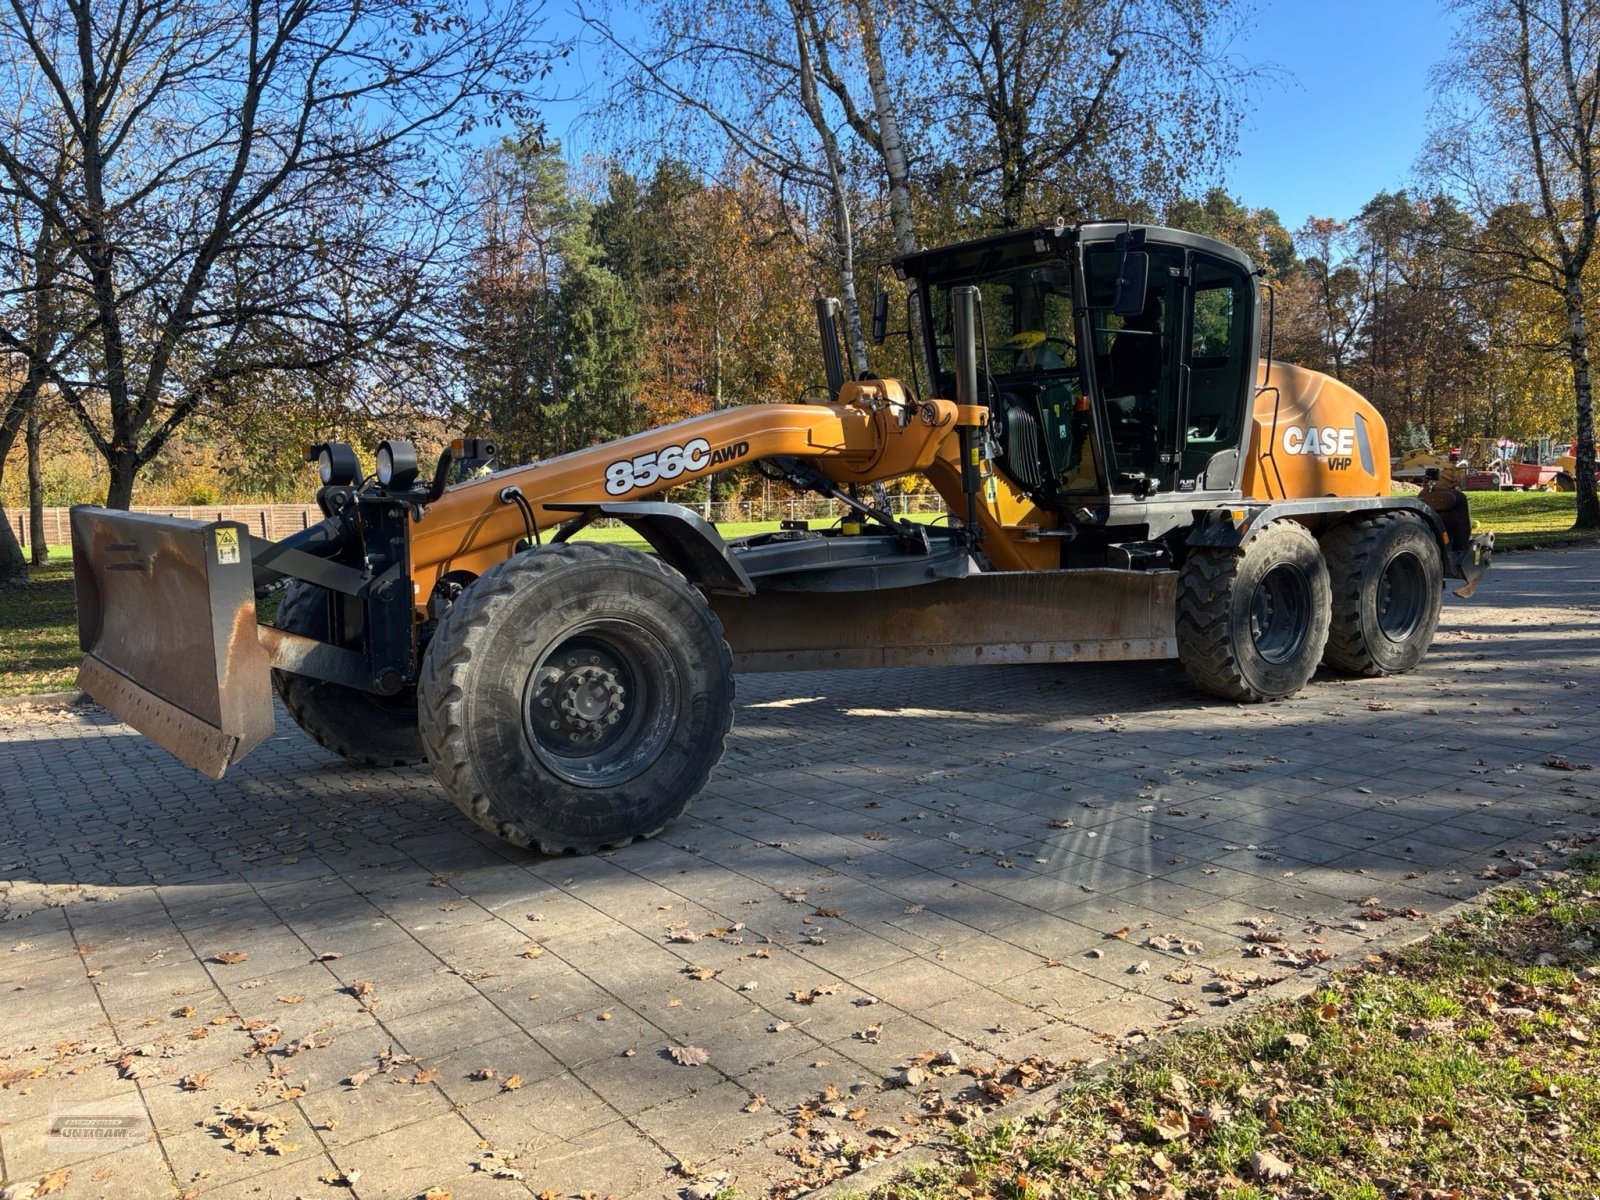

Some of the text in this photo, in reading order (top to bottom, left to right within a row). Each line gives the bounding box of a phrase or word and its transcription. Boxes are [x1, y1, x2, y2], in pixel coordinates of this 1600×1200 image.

[1283, 426, 1355, 455] CASE
[605, 437, 749, 496] 856C AWD
[1328, 458, 1351, 471] VHP
